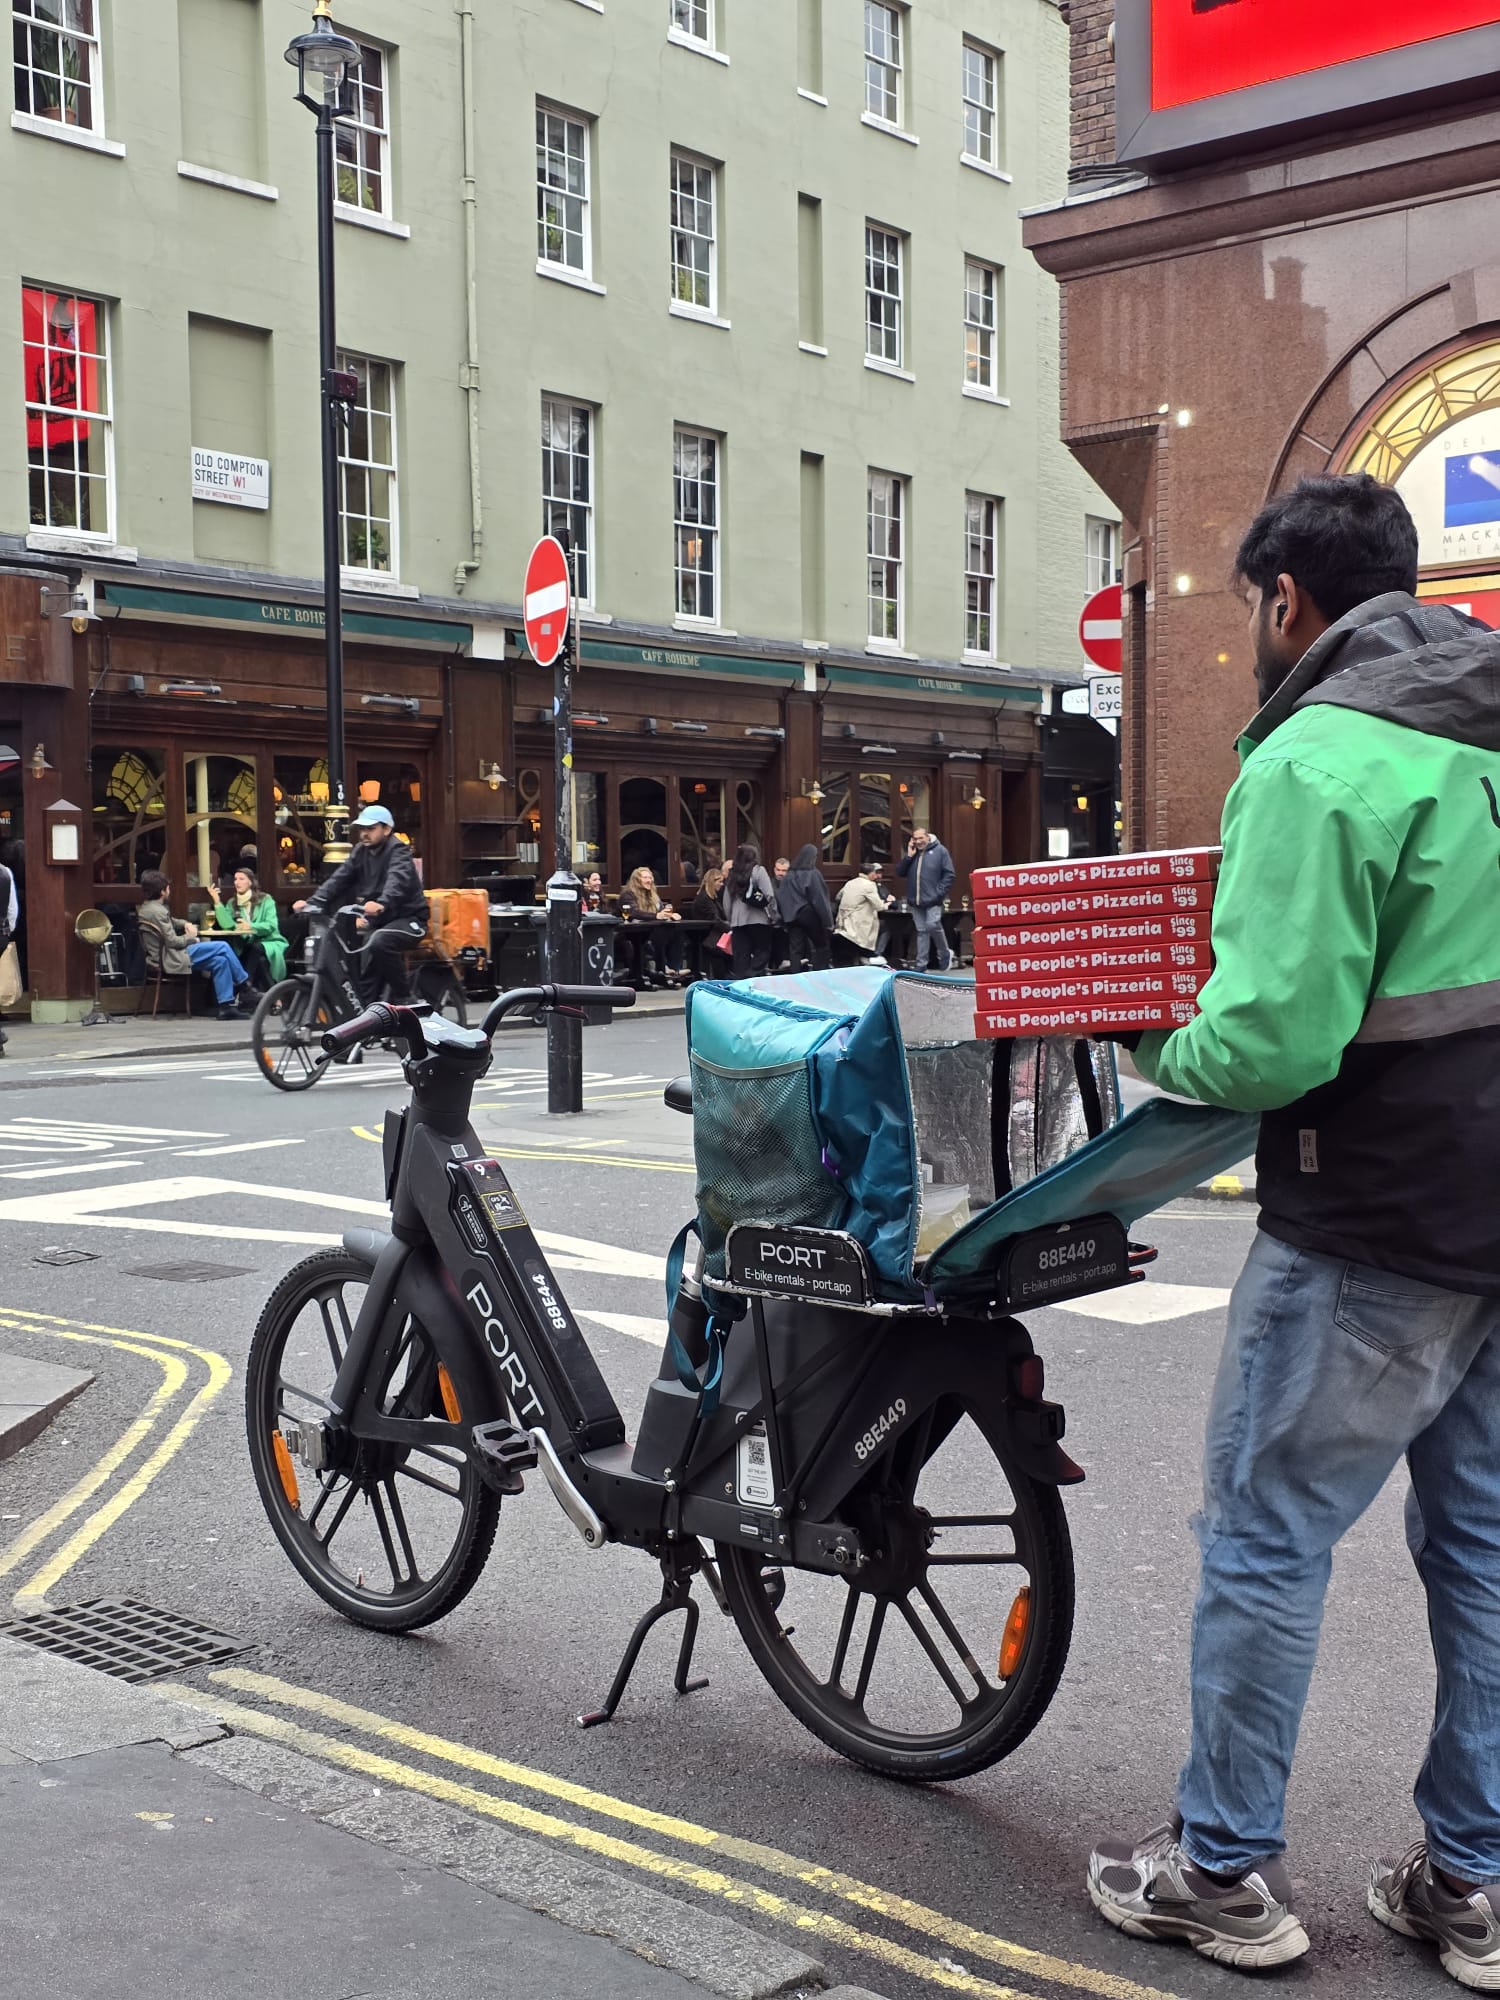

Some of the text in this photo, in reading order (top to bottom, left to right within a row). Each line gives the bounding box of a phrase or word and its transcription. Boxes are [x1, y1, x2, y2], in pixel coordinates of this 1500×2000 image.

[195, 453, 263, 477] OLD COMPTON
[195, 469, 246, 488] STREET W1
[261, 605, 290, 621] CAFE
[642, 650, 700, 666] CAFE BOHEME
[918, 678, 935, 688] CAFE
[1169, 856, 1195, 867] Since
[1170, 865, 1195, 877] '99
[985, 861, 1160, 889] The People's Pizzeria
[1171, 885, 1197, 896] Since
[987, 891, 1163, 917] The People's Pizzeria
[1172, 895, 1198, 907] '99
[1170, 916, 1196, 927] Since
[987, 921, 1162, 947] The People's Pizzeria
[1171, 926, 1196, 938] '99
[1170, 944, 1196, 956] Since
[1171, 954, 1196, 965] '99
[987, 949, 1162, 974] The People's Pizzeria
[1171, 972, 1197, 983] Since
[987, 977, 1163, 1001] The People's Pizzeria
[1172, 982, 1197, 994] '99
[1170, 1000, 1196, 1012] Since
[986, 1006, 1162, 1029] The People's Pizzeria
[760, 1242, 826, 1269] PORT
[1038, 1239, 1096, 1270] 88E449
[744, 1267, 773, 1282] E-bike
[775, 1273, 805, 1286] rentals
[813, 1279, 851, 1295] port.app
[1022, 1279, 1048, 1295] E-bike
[1050, 1272, 1077, 1287] rentals
[1084, 1262, 1117, 1280] port.app
[532, 1273, 566, 1329] 88E44
[466, 1280, 545, 1418] PORT
[854, 1398, 906, 1459] 88E449
